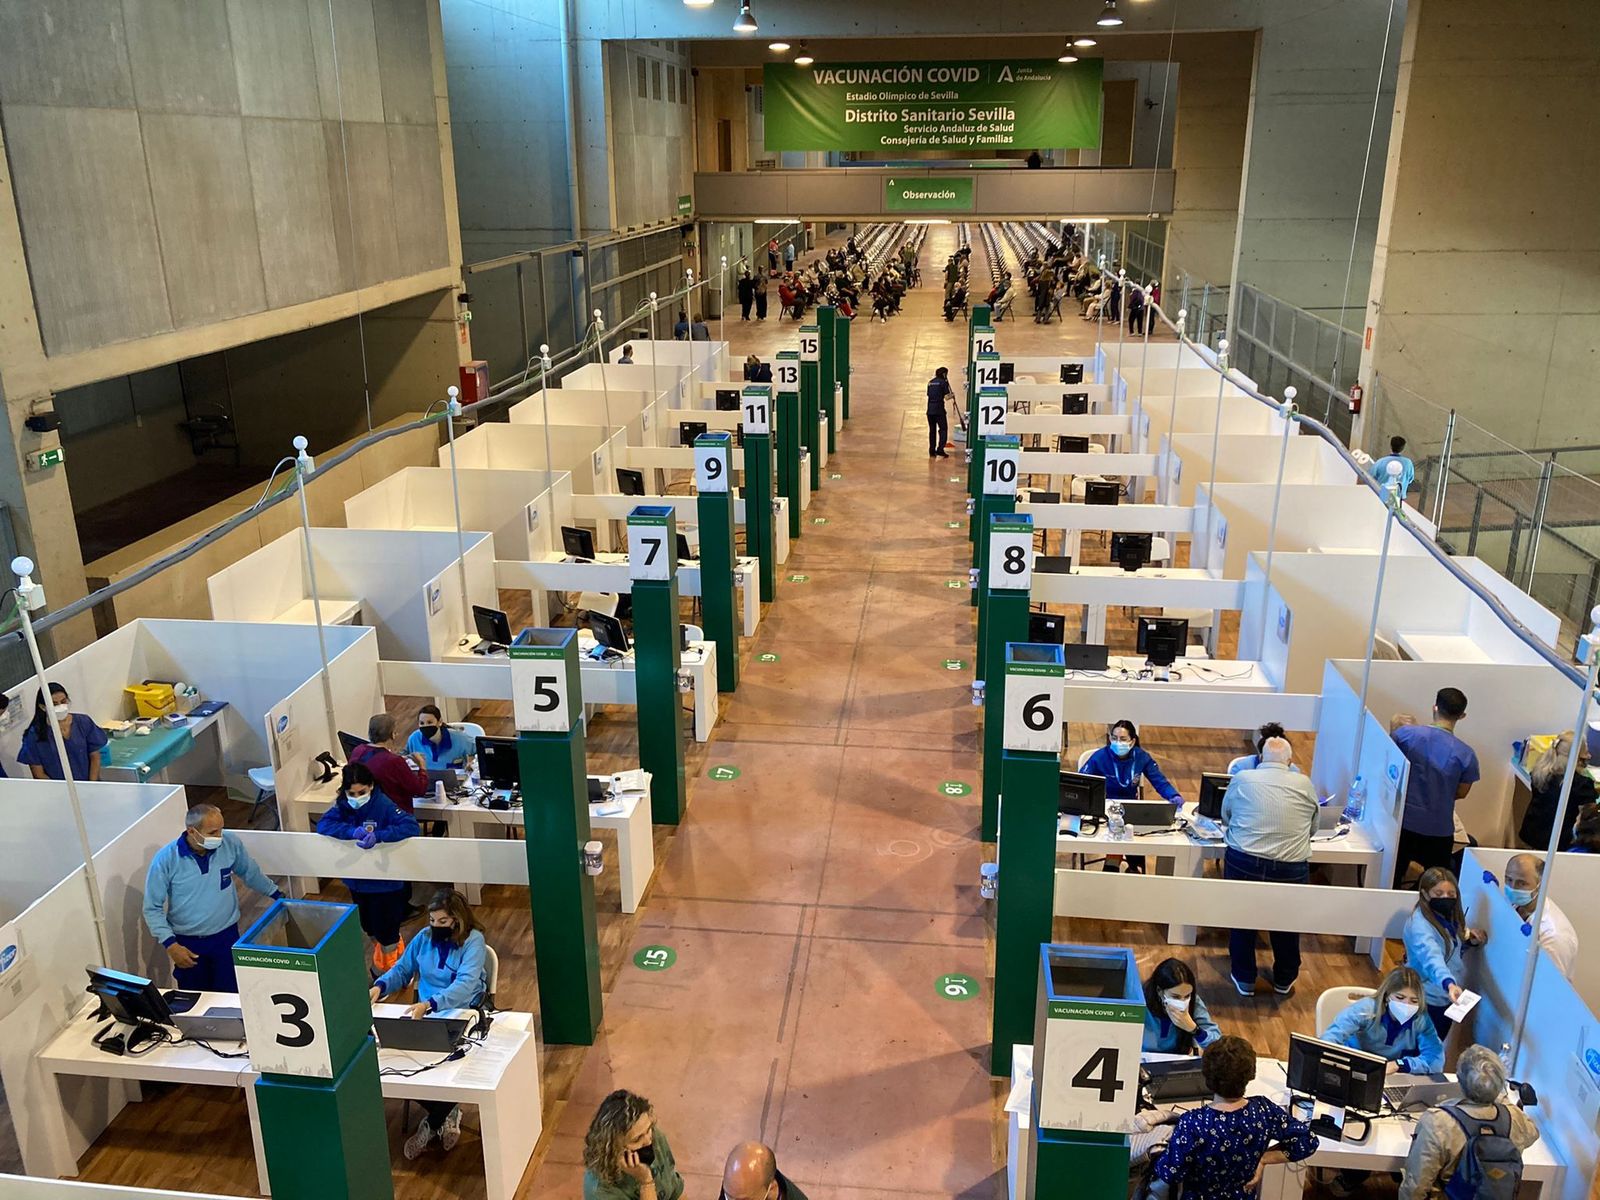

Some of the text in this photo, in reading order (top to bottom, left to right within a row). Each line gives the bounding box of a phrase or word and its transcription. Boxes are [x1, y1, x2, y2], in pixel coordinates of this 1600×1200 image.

[813, 65, 980, 85] VACUNACIÓN COVID
[846, 90, 959, 102] Estadio Olímpico de Sevilla
[845, 107, 1015, 122] Distrito Sanitario Sevilla
[904, 123, 1014, 133] Servicio Andaluz de Salud
[880, 135, 1014, 146] Consejería de Salud y Familias
[902, 190, 956, 199] Observación
[800, 339, 818, 353] 15
[976, 339, 993, 353] 16
[778, 367, 797, 383] 13
[977, 367, 998, 384] 14
[745, 404, 766, 423] 11
[980, 405, 1005, 425] 12
[705, 457, 722, 480] 9
[986, 459, 1016, 482] 10
[641, 538, 661, 565] 7
[1003, 545, 1026, 574] 8
[533, 676, 560, 712] 5
[1023, 693, 1054, 731] 6
[646, 950, 668, 960] 5
[270, 993, 315, 1048] 3
[1054, 1008, 1093, 1016] VACUNACIÓN
[1071, 1047, 1124, 1102] 4
